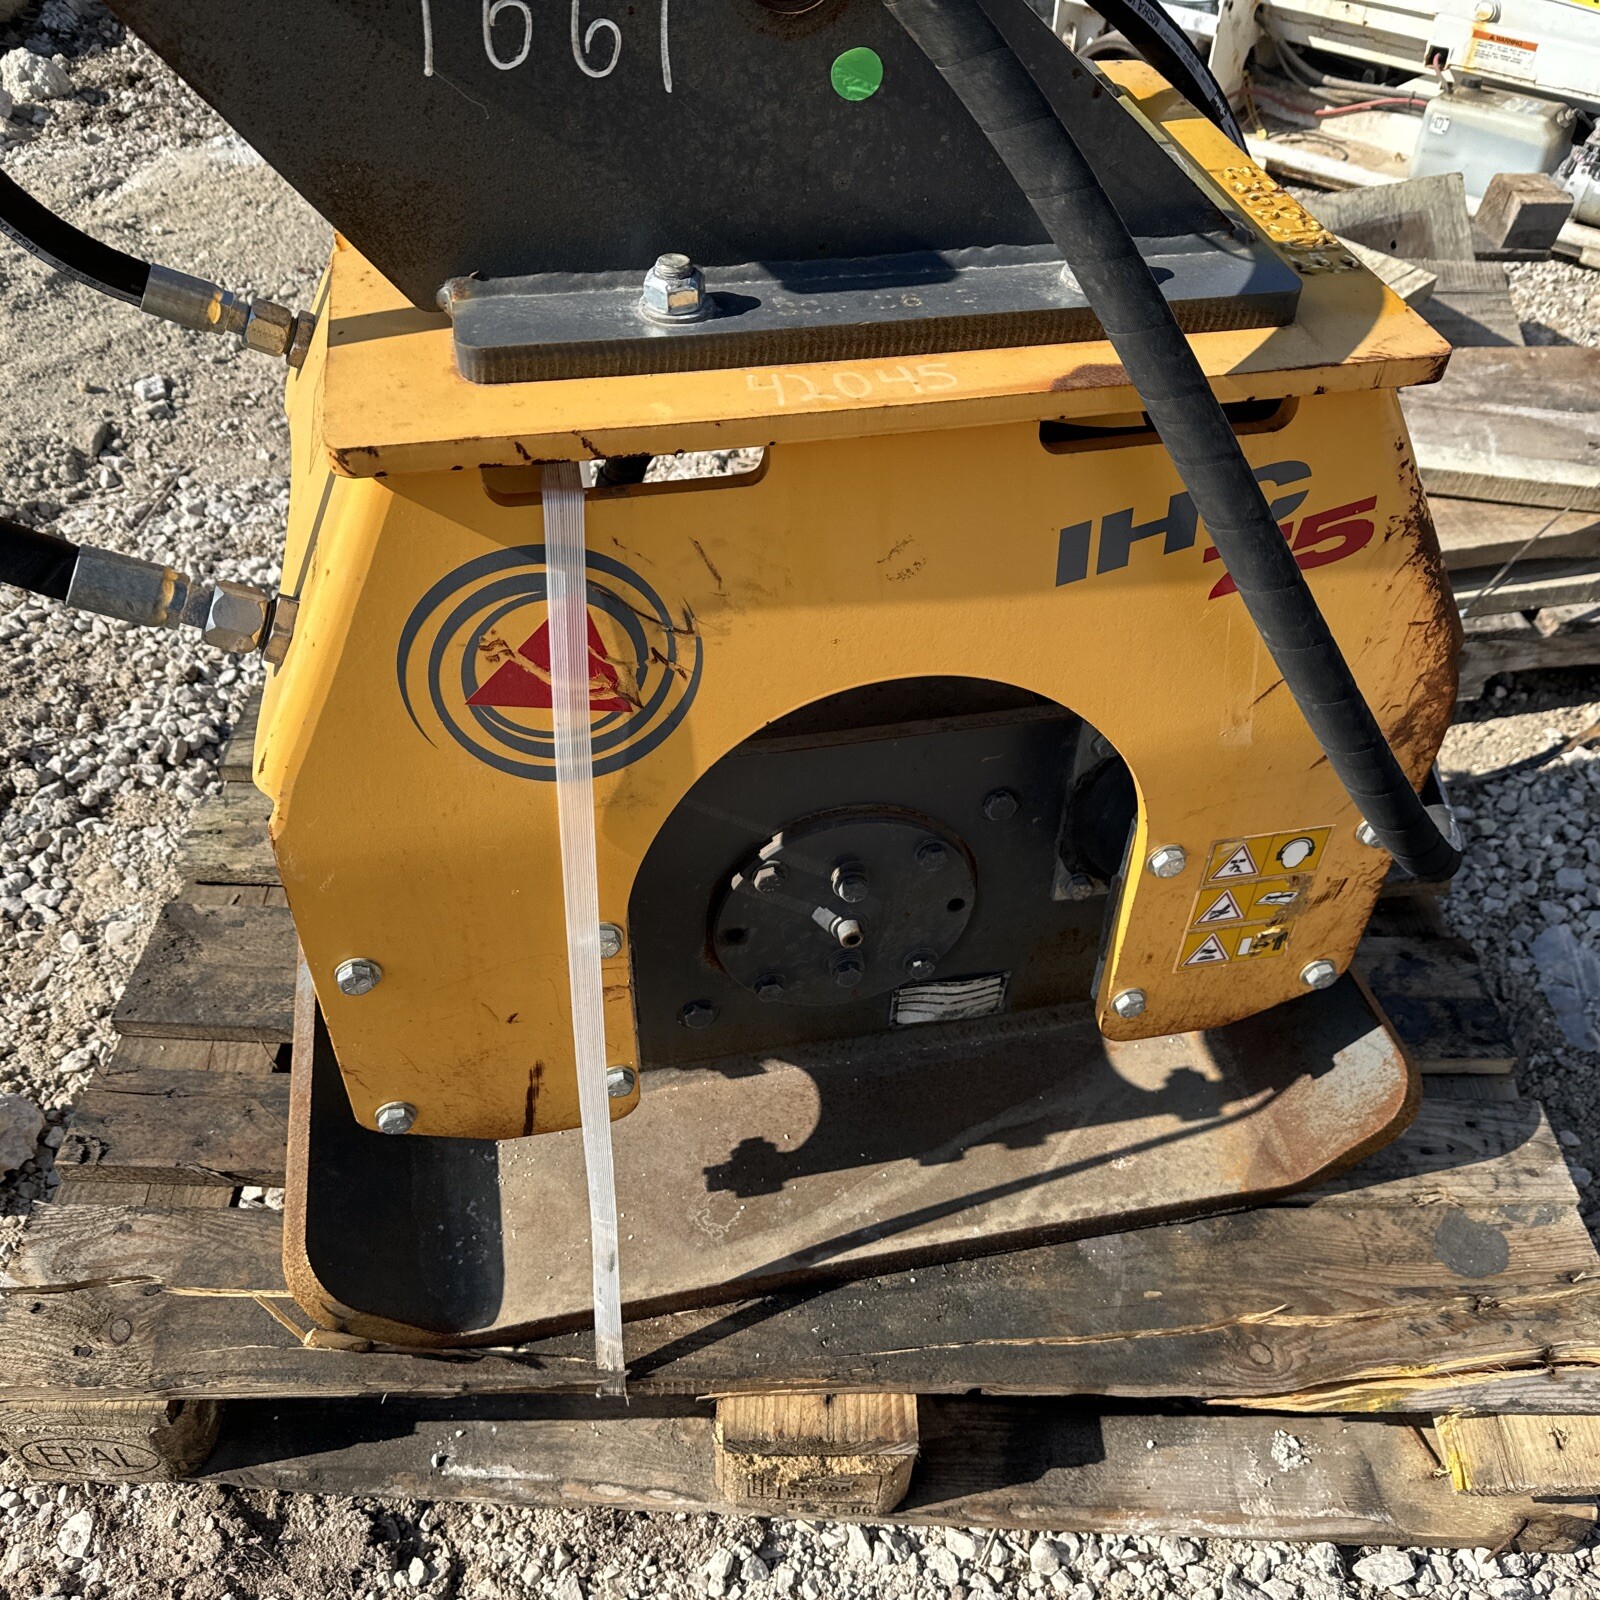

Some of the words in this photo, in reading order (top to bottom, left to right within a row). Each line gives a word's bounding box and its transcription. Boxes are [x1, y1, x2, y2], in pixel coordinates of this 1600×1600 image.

[421, 0, 672, 93] 1661
[1496, 35, 1523, 47] WARNING
[746, 363, 958, 406] 42045
[35, 1446, 144, 1468] EPAL
